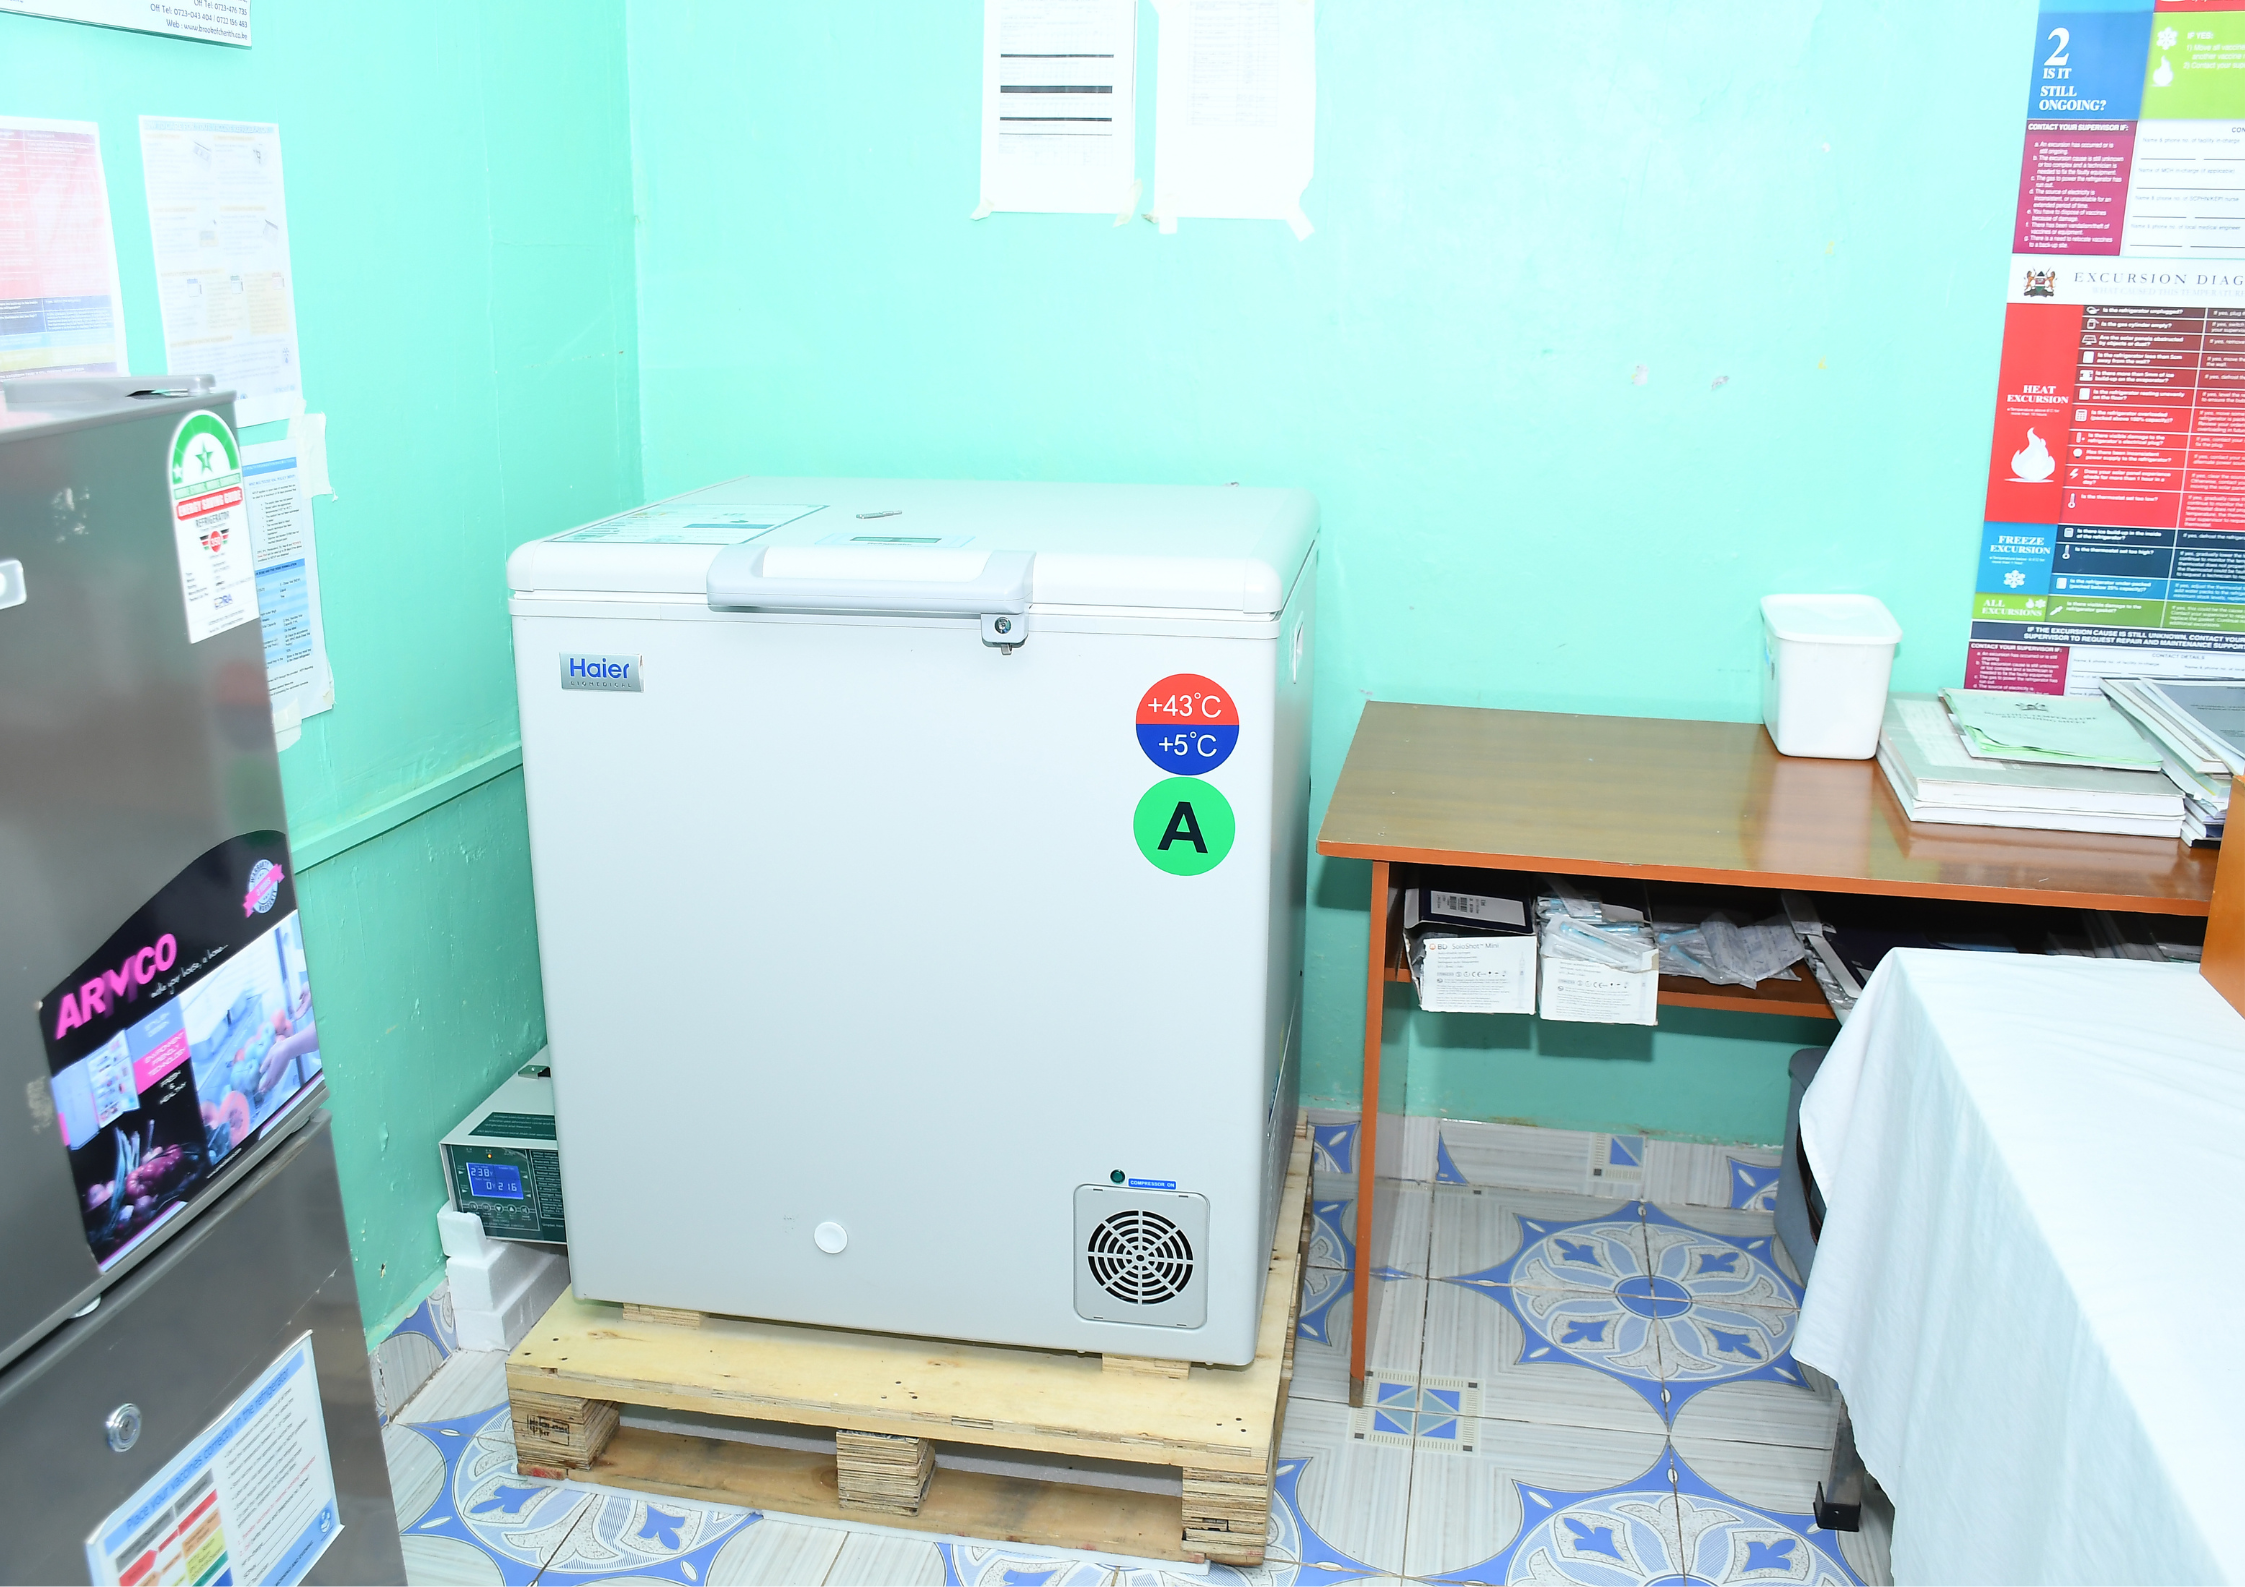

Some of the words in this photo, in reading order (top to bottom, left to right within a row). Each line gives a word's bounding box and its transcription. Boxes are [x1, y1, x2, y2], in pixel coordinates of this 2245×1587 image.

[2044, 27, 2071, 66] 2
[2043, 68, 2056, 79] IS
[2057, 68, 2073, 79] IT
[2040, 86, 2077, 97] STILL
[2039, 99, 2107, 111] ONGOING?
[2028, 123, 2058, 131] CONTACT
[2059, 123, 2078, 131] YOUR
[2078, 124, 2119, 132] SUPERVISOR
[2074, 272, 2188, 285] EXCURSION
[2119, 307, 2149, 316] refrigerator
[2023, 385, 2057, 394] HEAT
[2007, 394, 2069, 404] EXCURSION
[1998, 535, 2045, 546] FREEZE
[1989, 544, 2051, 555] EXCURSION
[1983, 599, 2006, 607] ALL
[1981, 607, 2043, 616] EXCURSIONS
[2023, 632, 2070, 640] SUPERVISOR
[2115, 637, 2143, 645] REPAIR
[2159, 640, 2213, 649] MAINTENANCE
[2050, 628, 2092, 636] EXCURSION
[2188, 634, 2224, 642] CONTACT
[569, 657, 631, 679] Haier
[1157, 801, 1209, 854] A
[55, 933, 178, 1041] ARMCO
[127, 1507, 150, 1531] Place
